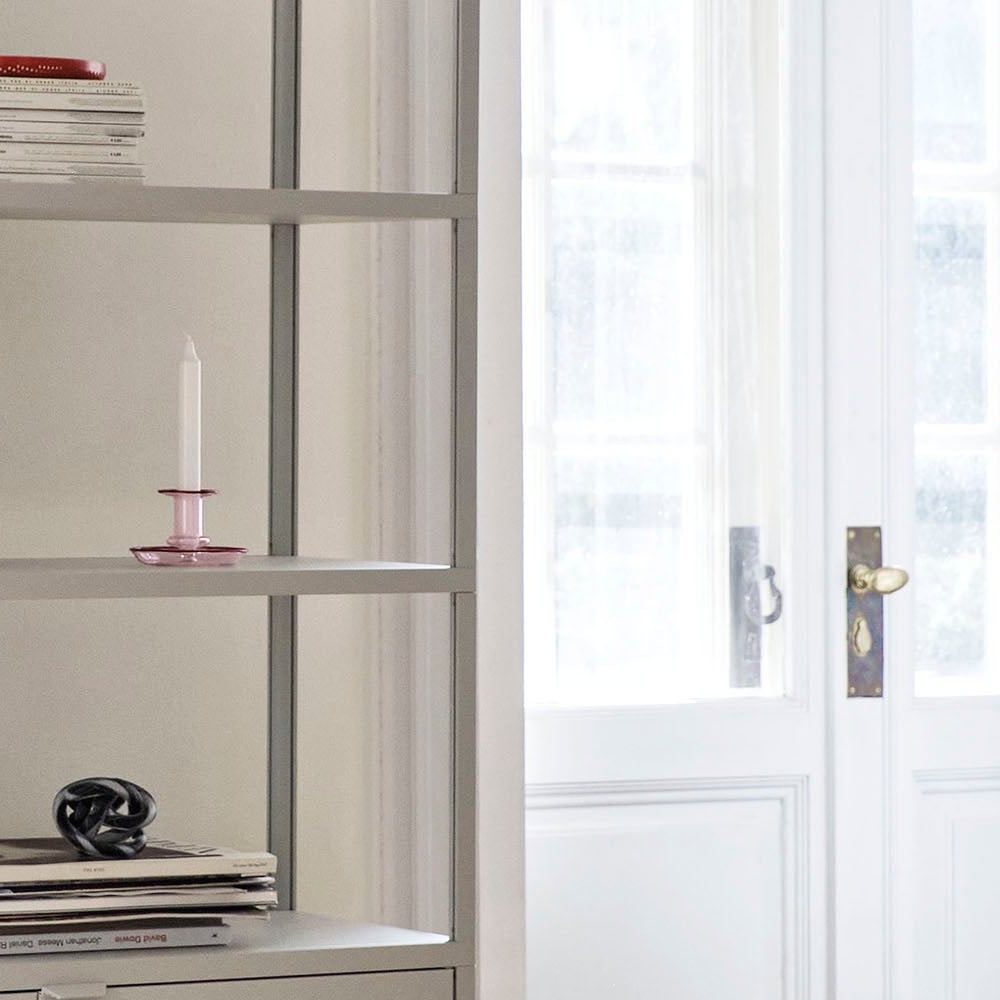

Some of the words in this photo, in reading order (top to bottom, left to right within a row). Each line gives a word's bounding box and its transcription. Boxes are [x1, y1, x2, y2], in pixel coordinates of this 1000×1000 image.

[38, 939, 64, 947] Meese
[114, 935, 141, 944] Dowie
[143, 934, 167, 943] Bavid
[9, 940, 34, 949] Daniel
